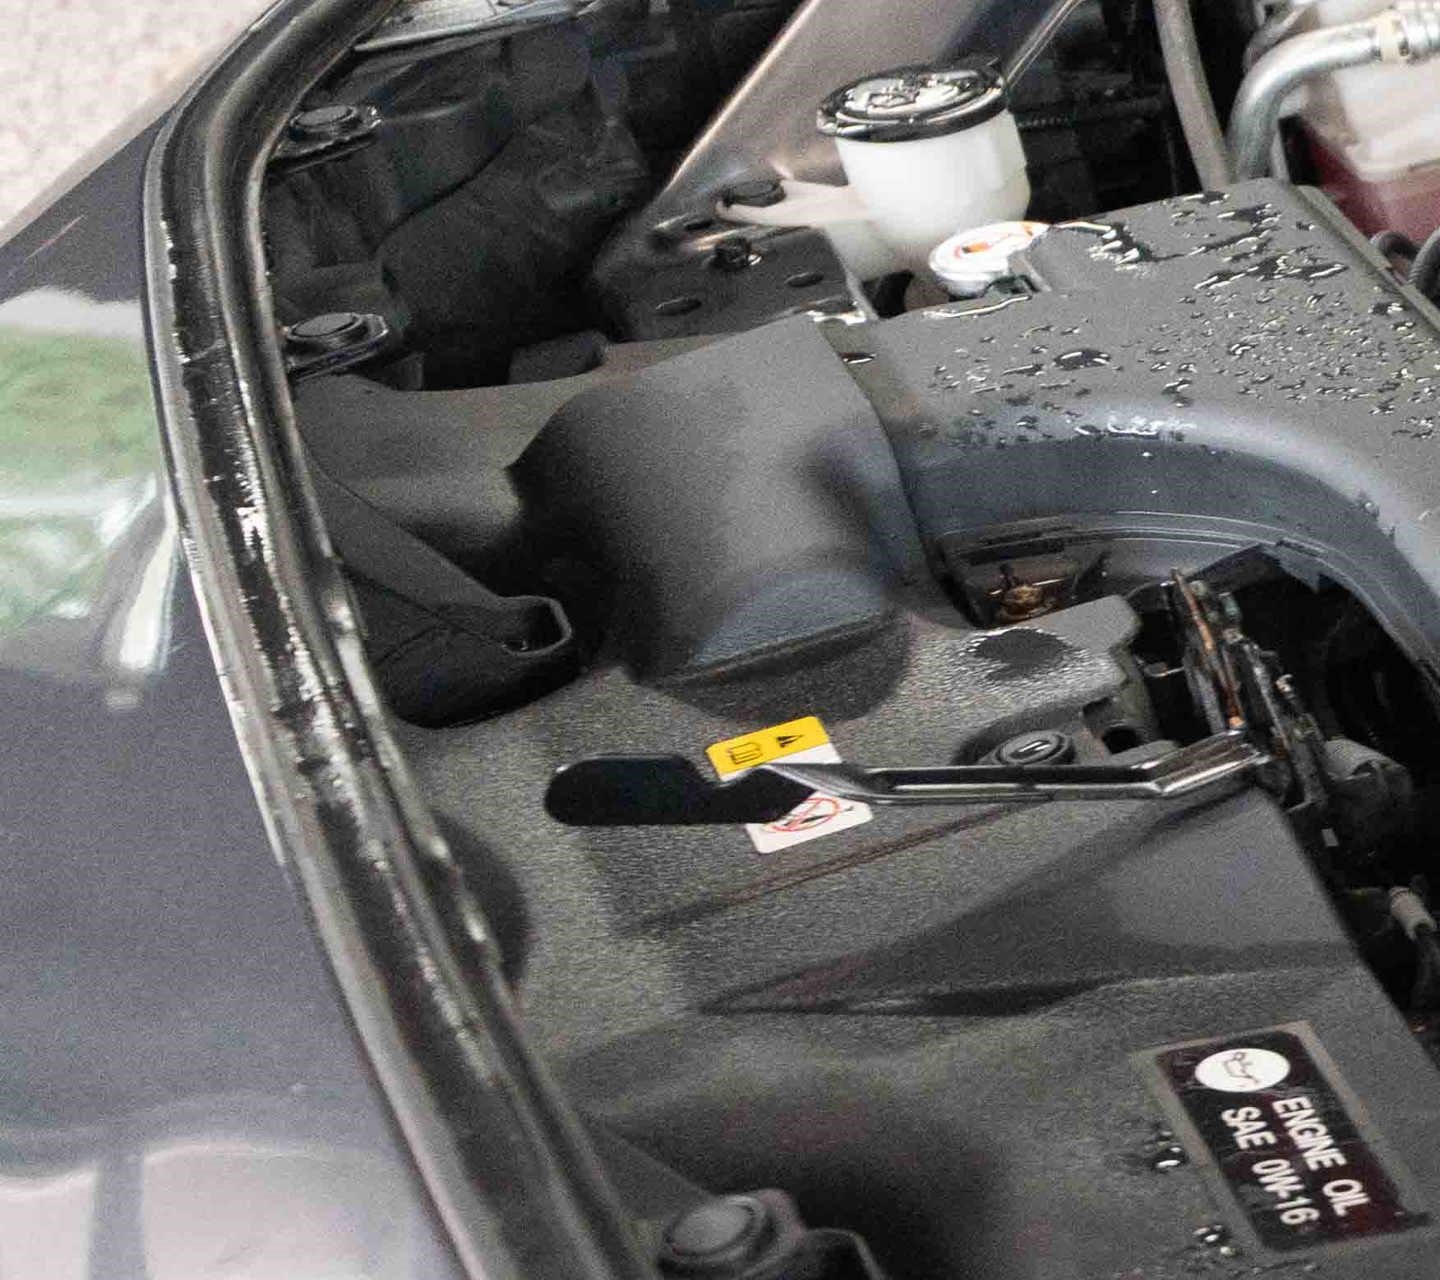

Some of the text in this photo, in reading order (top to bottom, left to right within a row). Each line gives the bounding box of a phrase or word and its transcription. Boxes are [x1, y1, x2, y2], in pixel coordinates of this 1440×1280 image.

[1220, 1106, 1277, 1150] SAE
[1272, 1096, 1371, 1216] ENGINE OIL
